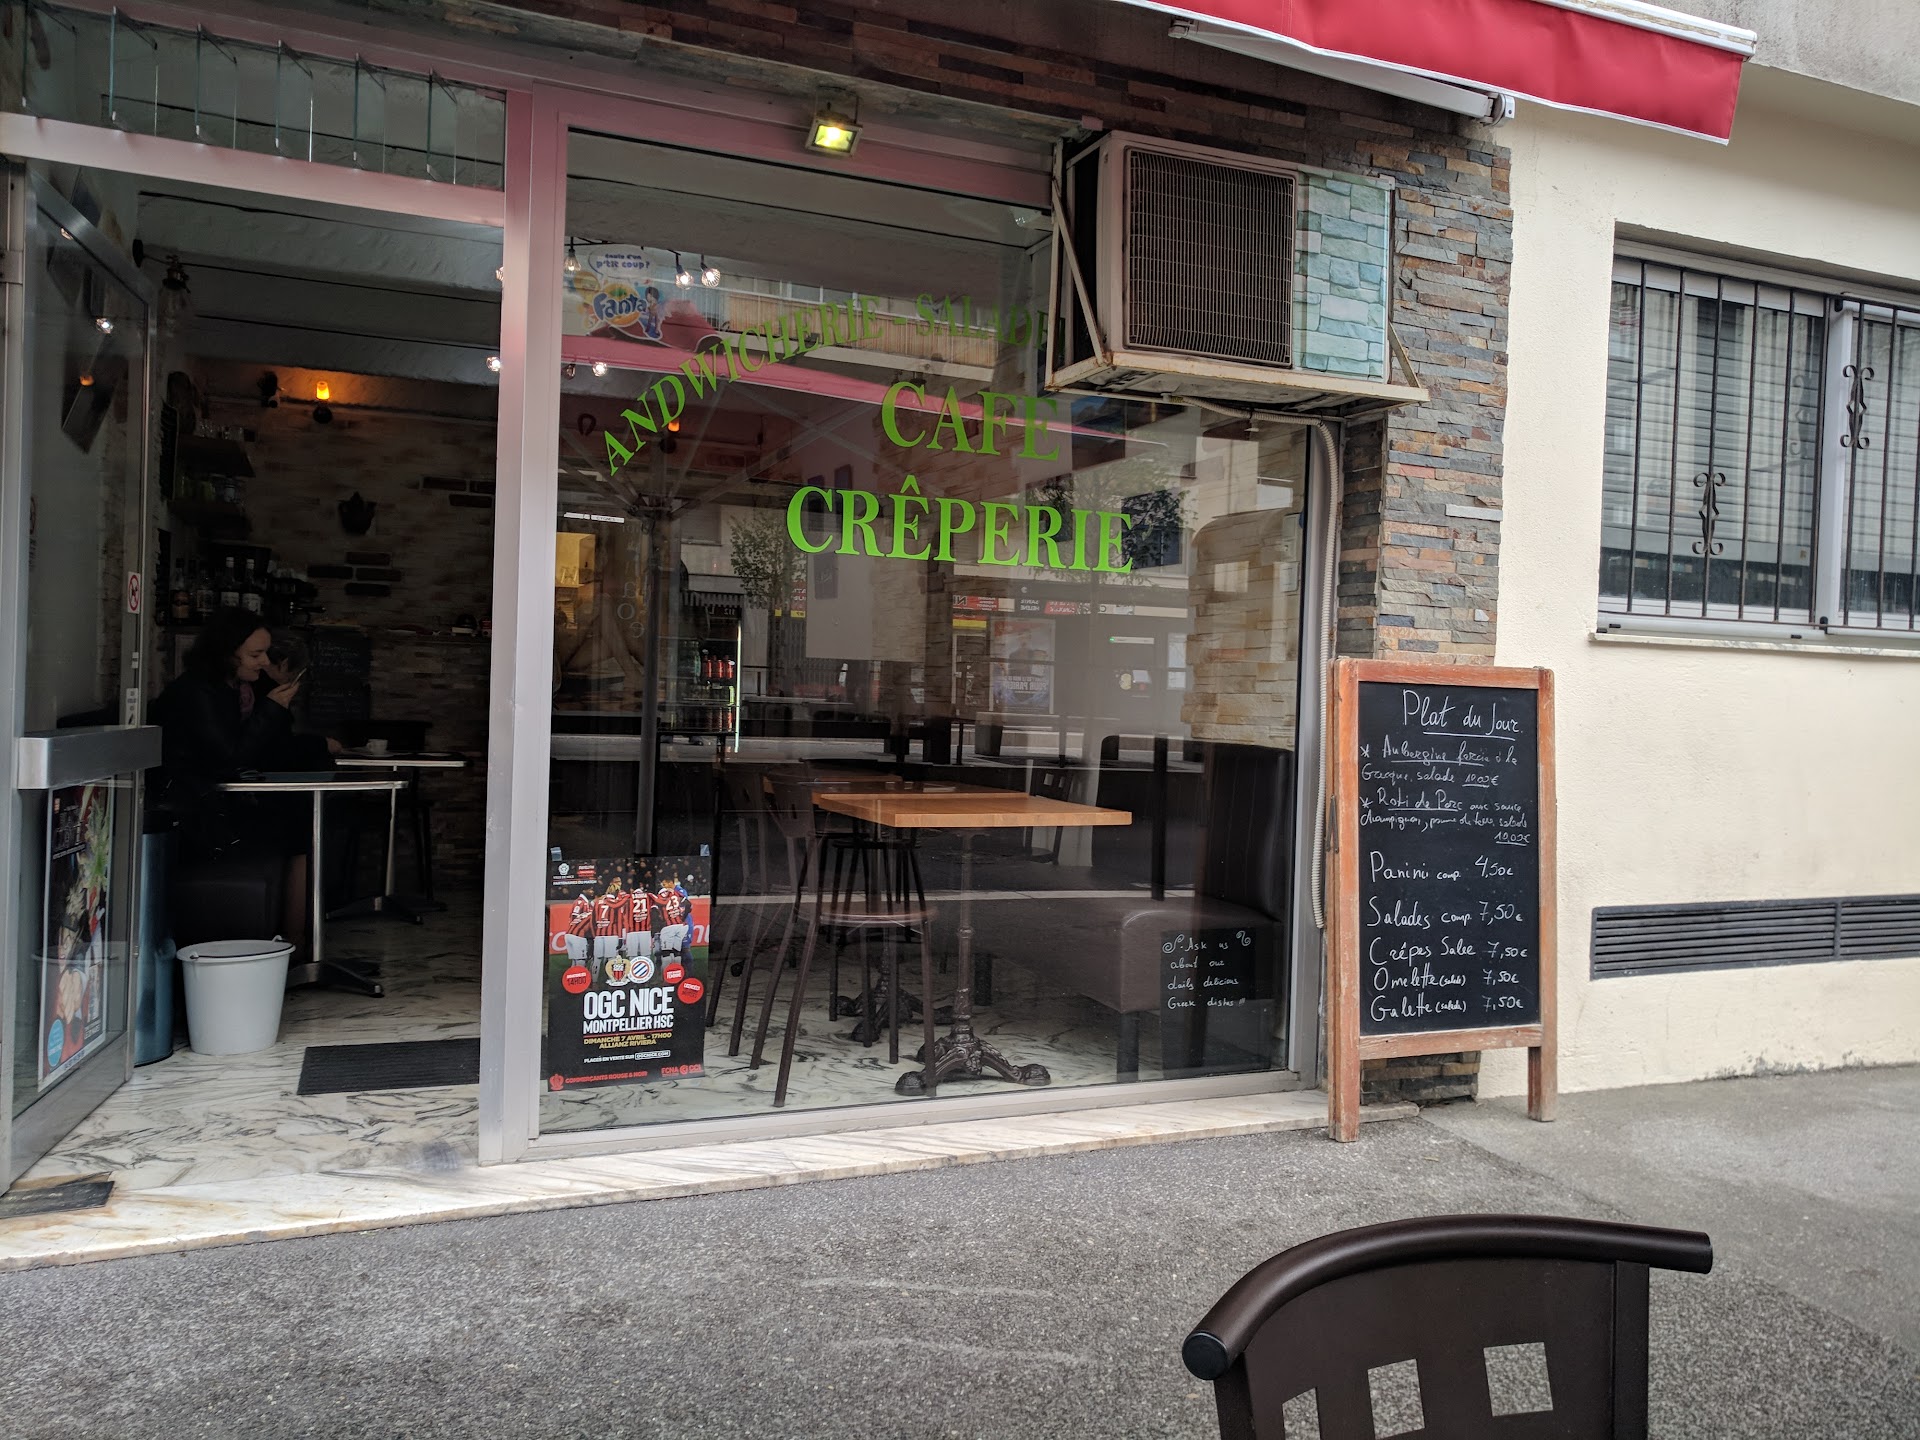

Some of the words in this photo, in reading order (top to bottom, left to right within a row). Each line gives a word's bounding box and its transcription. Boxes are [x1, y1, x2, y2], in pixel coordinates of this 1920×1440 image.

[593, 292, 648, 321] Fanta
[599, 295, 885, 477] ANDWICHERIE
[786, 475, 1133, 576] CRÊPERIE
[1402, 689, 1456, 727] Plat
[1463, 704, 1482, 728] du
[1382, 734, 1446, 766] Aubergine
[1505, 745, 1519, 766] la
[1416, 766, 1455, 782] salade
[1376, 787, 1409, 808] Roti
[1414, 790, 1430, 808] de
[1435, 788, 1463, 811] Porc
[1494, 802, 1522, 813] sauce
[1459, 812, 1472, 826] de
[1499, 812, 1528, 828] salade
[1369, 850, 1429, 883] Panini
[1474, 854, 1514, 878] 4,50€
[600, 905, 609, 919] 7
[633, 898, 648, 913] 21
[665, 895, 680, 911] 23
[1366, 895, 1431, 931] Salades
[1478, 900, 1524, 926] 7,50€
[1218, 942, 1229, 951] us
[1369, 936, 1432, 967] Crêpes
[1486, 940, 1528, 960] 7,50€
[1170, 956, 1198, 970] about
[1208, 960, 1225, 968] our
[1167, 976, 1194, 991] daily
[1203, 975, 1239, 988] delicious
[1374, 961, 1439, 991] Omelette
[1482, 968, 1520, 986] 7,50€
[583, 989, 626, 1020] OGC
[629, 986, 675, 1017] NICE
[1167, 996, 1196, 1010] Greek
[1206, 997, 1234, 1007] dishes
[1370, 991, 1432, 1022] Galette
[1481, 994, 1524, 1013] 7,50€
[583, 1016, 653, 1035] MONTPELLIER
[653, 1014, 674, 1029] HSC
[583, 1036, 620, 1045] DIMANCHE
[626, 1034, 647, 1042] AVRIL
[651, 1032, 672, 1040] 17H00
[599, 1042, 630, 1050] ALLIANZ
[629, 1039, 657, 1047] RIVIERA
[608, 1072, 629, 1080] ROUGE
[633, 1070, 648, 1078] NOIR
